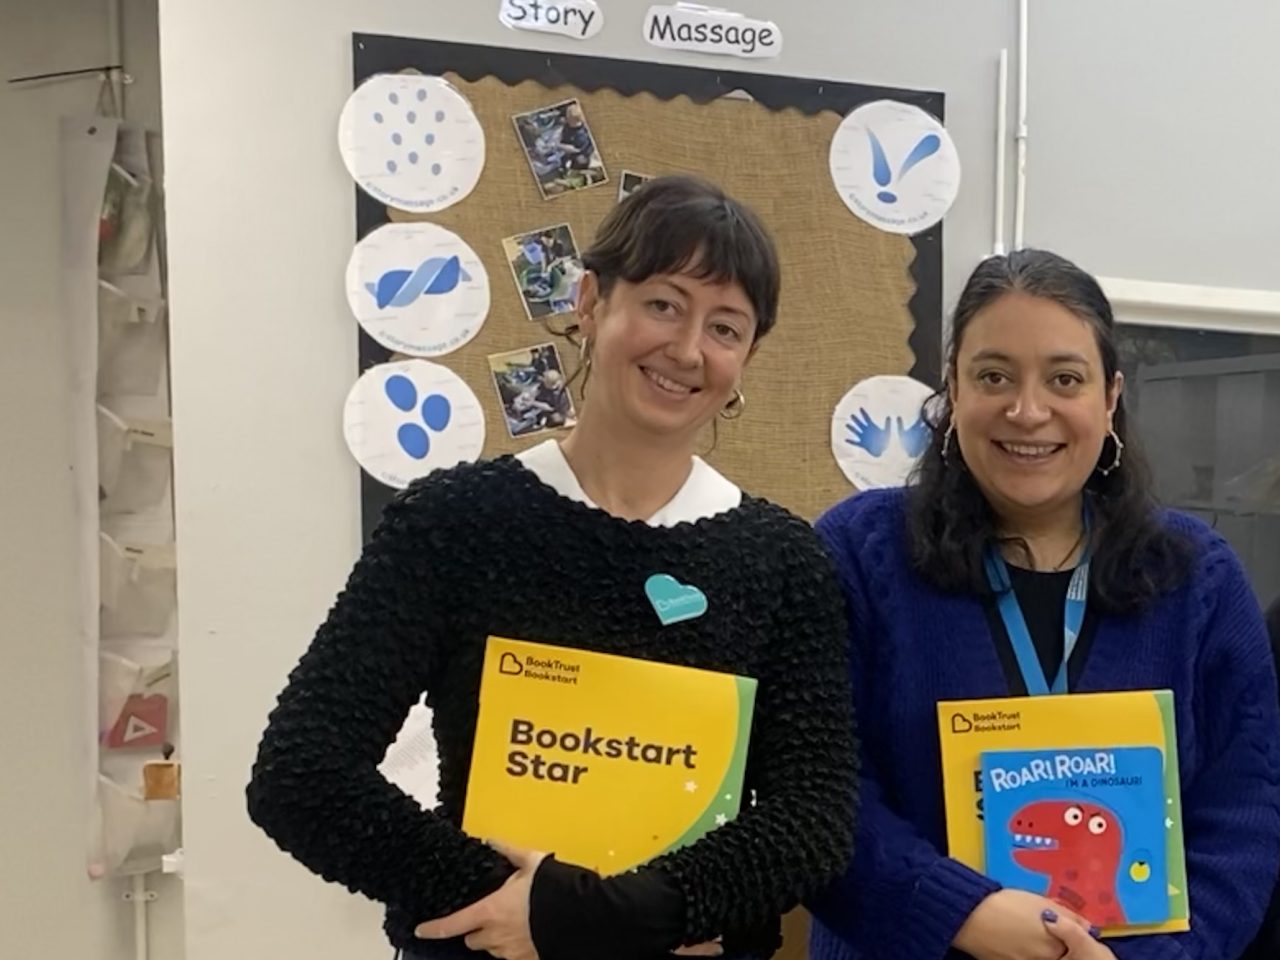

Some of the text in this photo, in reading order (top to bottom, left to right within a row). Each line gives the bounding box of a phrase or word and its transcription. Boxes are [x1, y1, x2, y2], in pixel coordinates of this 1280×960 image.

[507, 0, 775, 53] Story Massage
[524, 670, 579, 685] Bookstart
[526, 656, 581, 673] BookTrust
[510, 718, 699, 770] Bookstart
[506, 751, 590, 785] Star
[990, 759, 1055, 792] ROAR!
[1055, 752, 1117, 780] ROAR!
